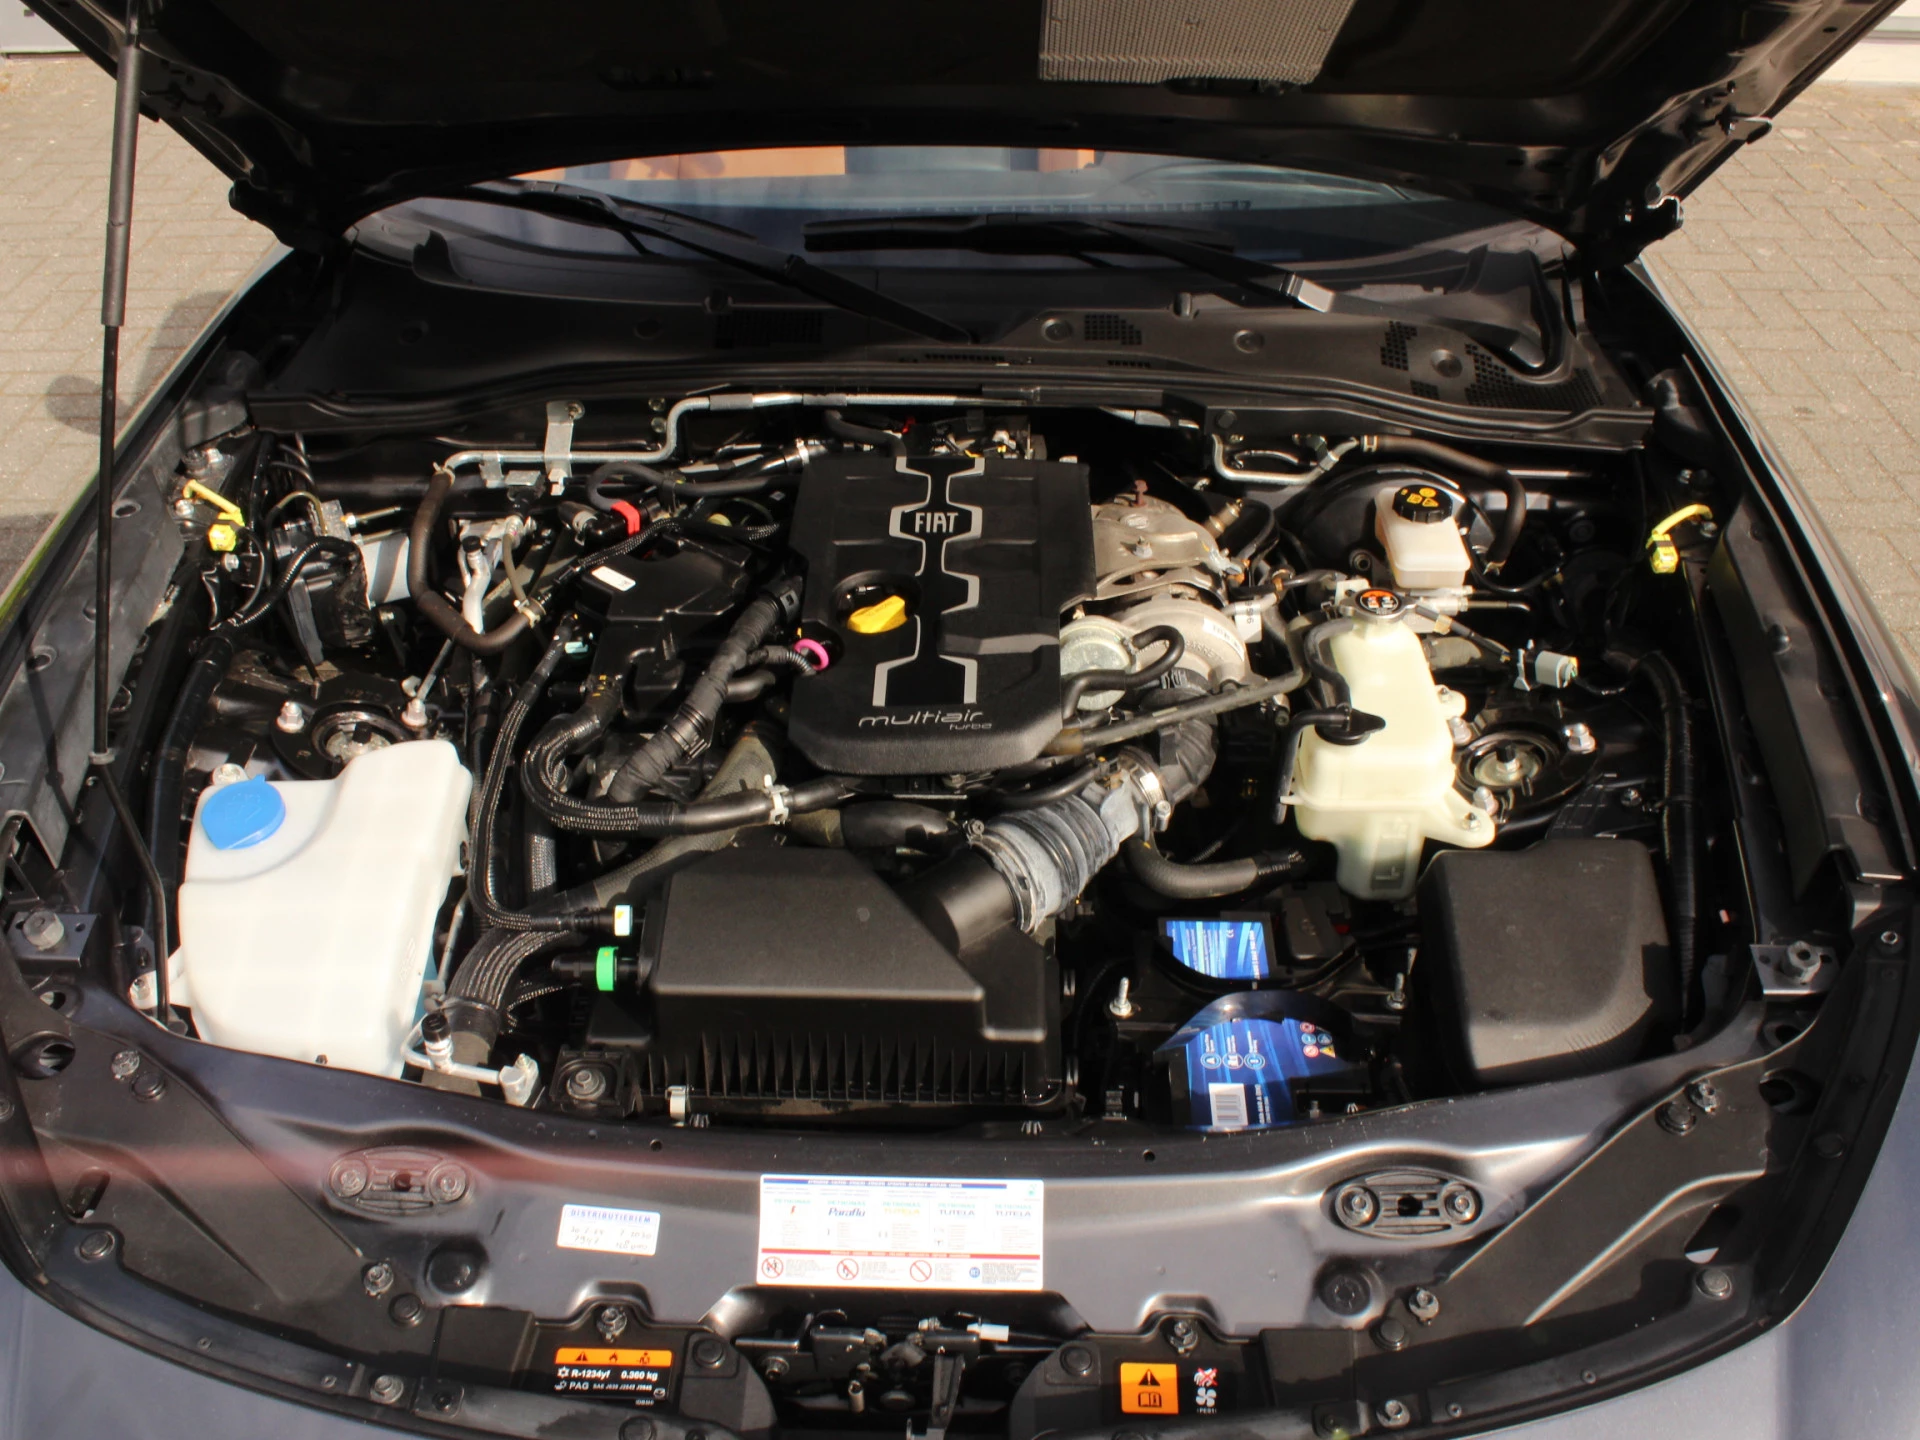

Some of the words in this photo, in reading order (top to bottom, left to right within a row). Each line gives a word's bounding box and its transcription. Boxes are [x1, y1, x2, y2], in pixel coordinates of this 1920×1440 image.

[915, 512, 958, 533] FIAT
[858, 710, 984, 728] multiair
[949, 722, 992, 731] turbo
[939, 1209, 976, 1217] TUTELA
[995, 1210, 1032, 1218] TUTELA
[571, 1369, 611, 1381] R-1234yf
[646, 1371, 658, 1382] kg
[569, 1381, 589, 1390] PAG
